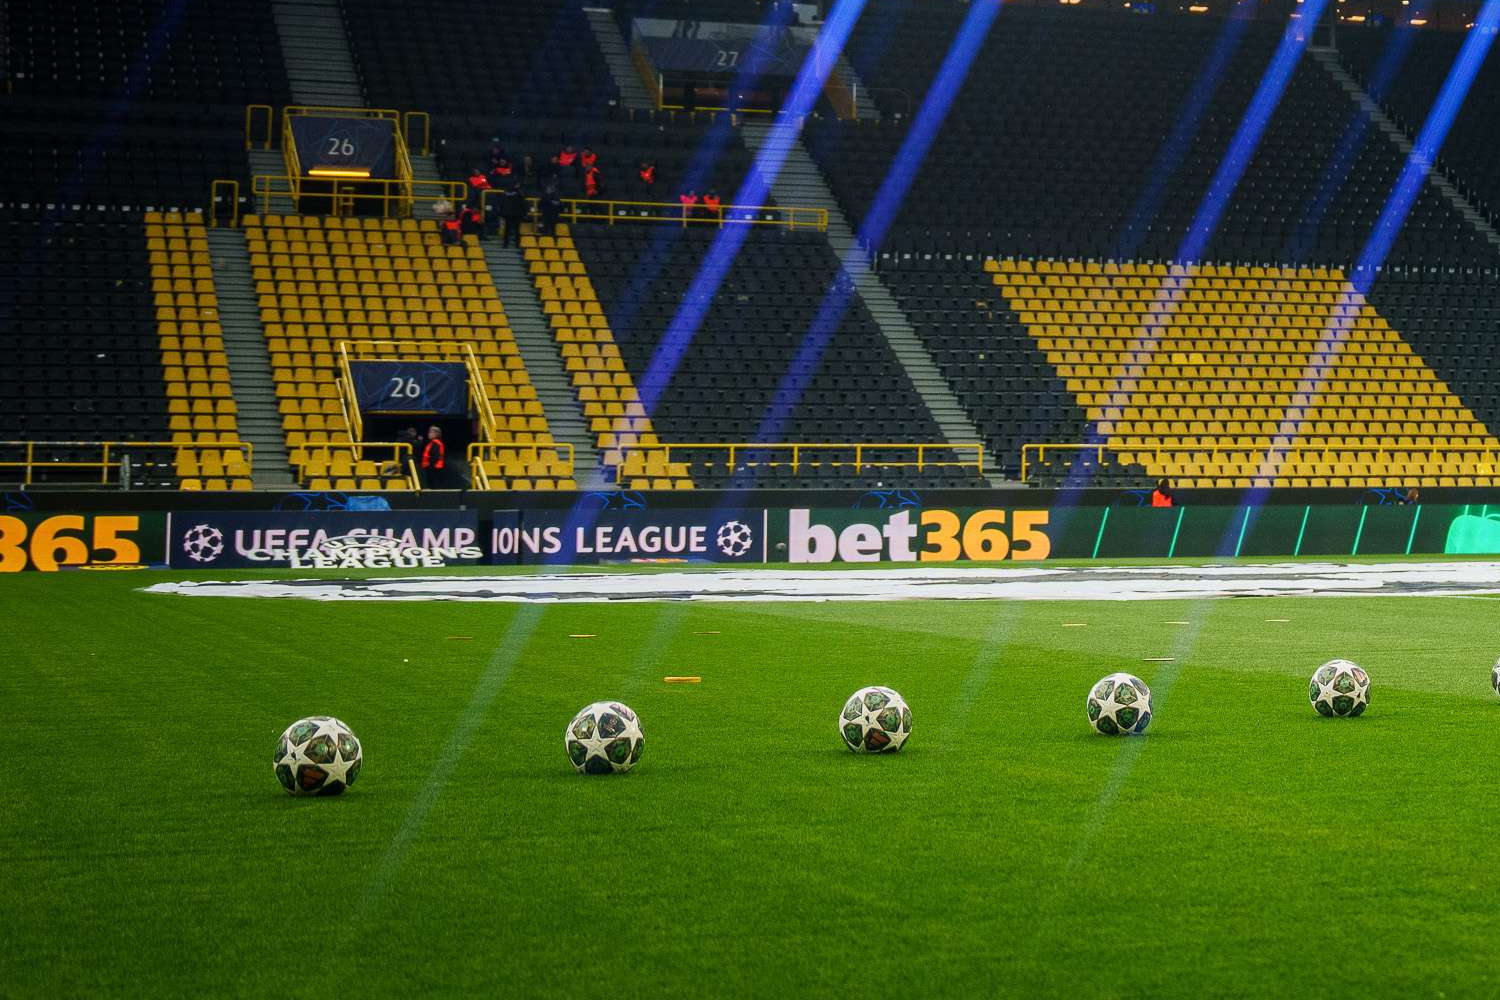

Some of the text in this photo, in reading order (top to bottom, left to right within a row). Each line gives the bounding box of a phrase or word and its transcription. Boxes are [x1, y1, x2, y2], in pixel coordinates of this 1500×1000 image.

[717, 50, 738, 67] 27
[328, 138, 354, 157] 26
[390, 377, 421, 398] 26
[235, 528, 332, 557] UEFA
[575, 526, 708, 553] LEAGUE
[788, 508, 1051, 562] bet365
